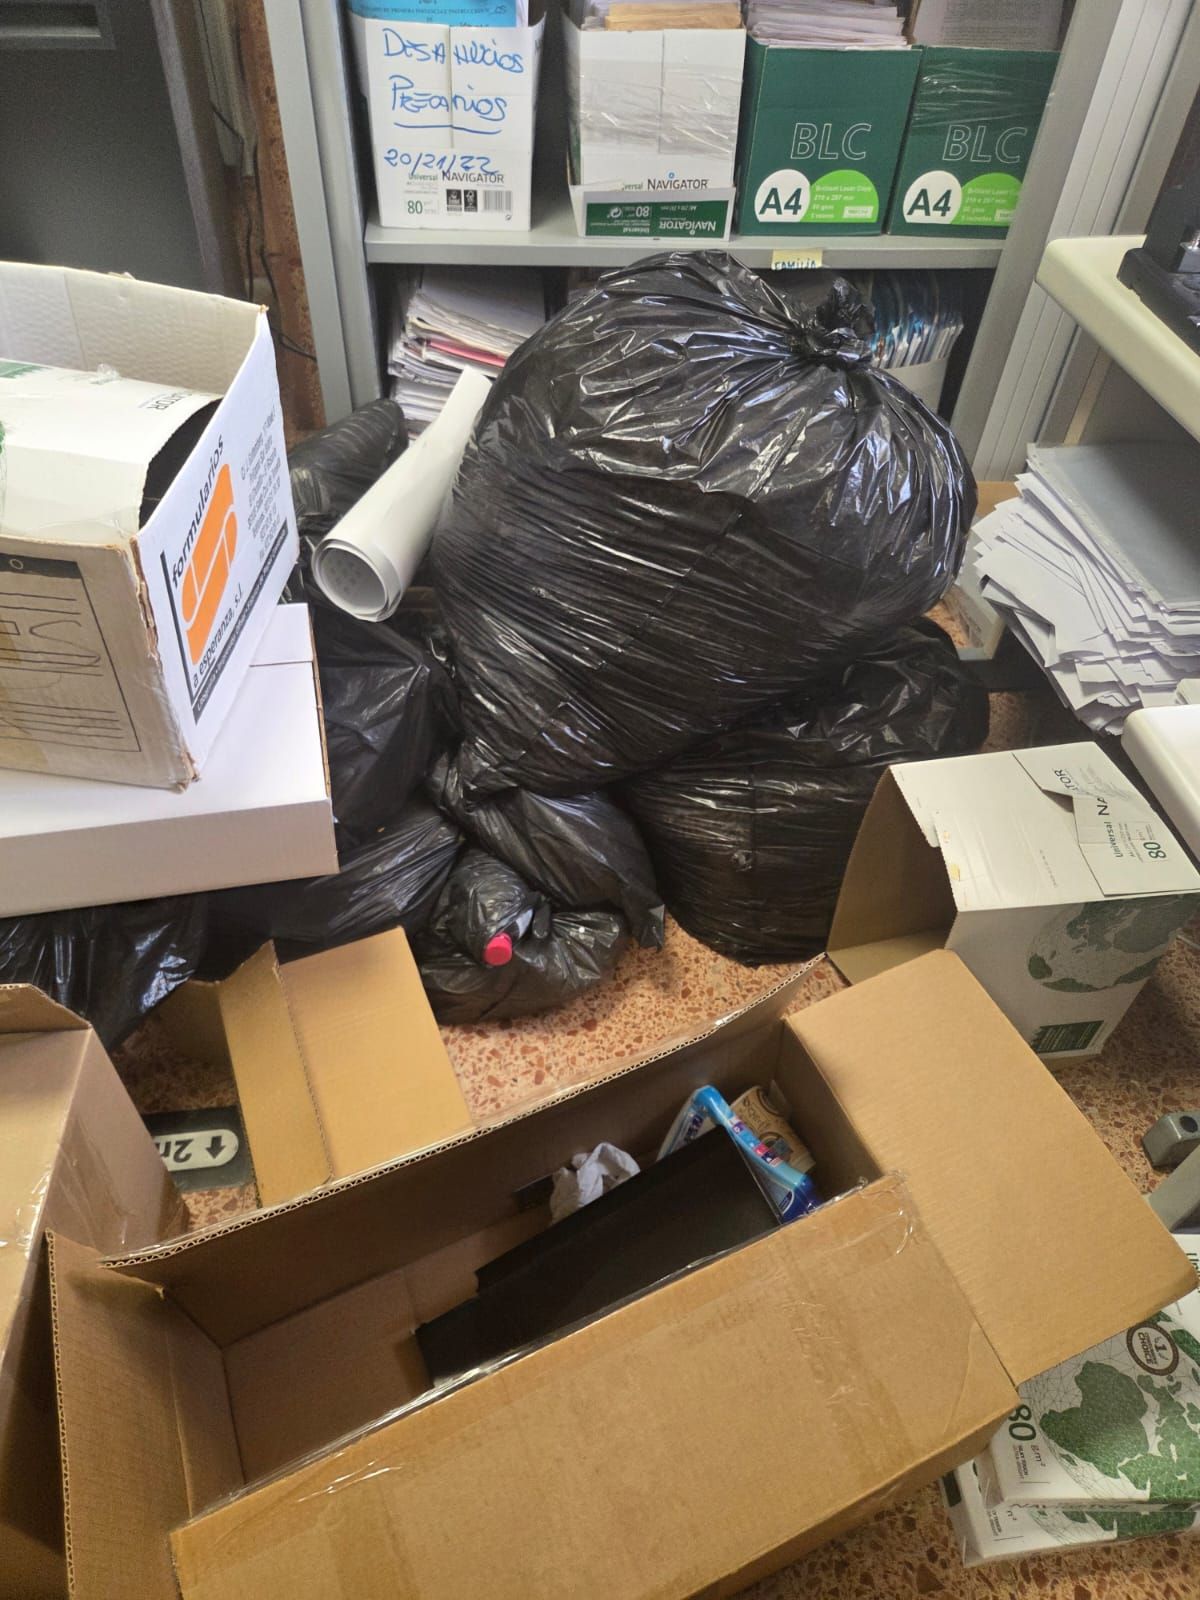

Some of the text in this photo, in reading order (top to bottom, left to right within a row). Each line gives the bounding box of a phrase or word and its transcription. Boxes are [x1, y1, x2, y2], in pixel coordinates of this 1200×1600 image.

[790, 122, 872, 160] BLC
[942, 124, 1028, 164] BLC
[442, 170, 505, 183] NAVIGATOR
[624, 179, 709, 190] versal NAVIGATOR
[407, 200, 423, 214] 80
[635, 206, 650, 218] 80
[758, 187, 802, 216] A4
[906, 188, 952, 217] A4
[659, 219, 717, 235] NAVIGATOR
[172, 434, 224, 589] formularios
[1104, 821, 1124, 858] Universal
[1143, 841, 1167, 859] 80
[1137, 1332, 1154, 1365] CHOICE
[1007, 1404, 1037, 1441] 80
